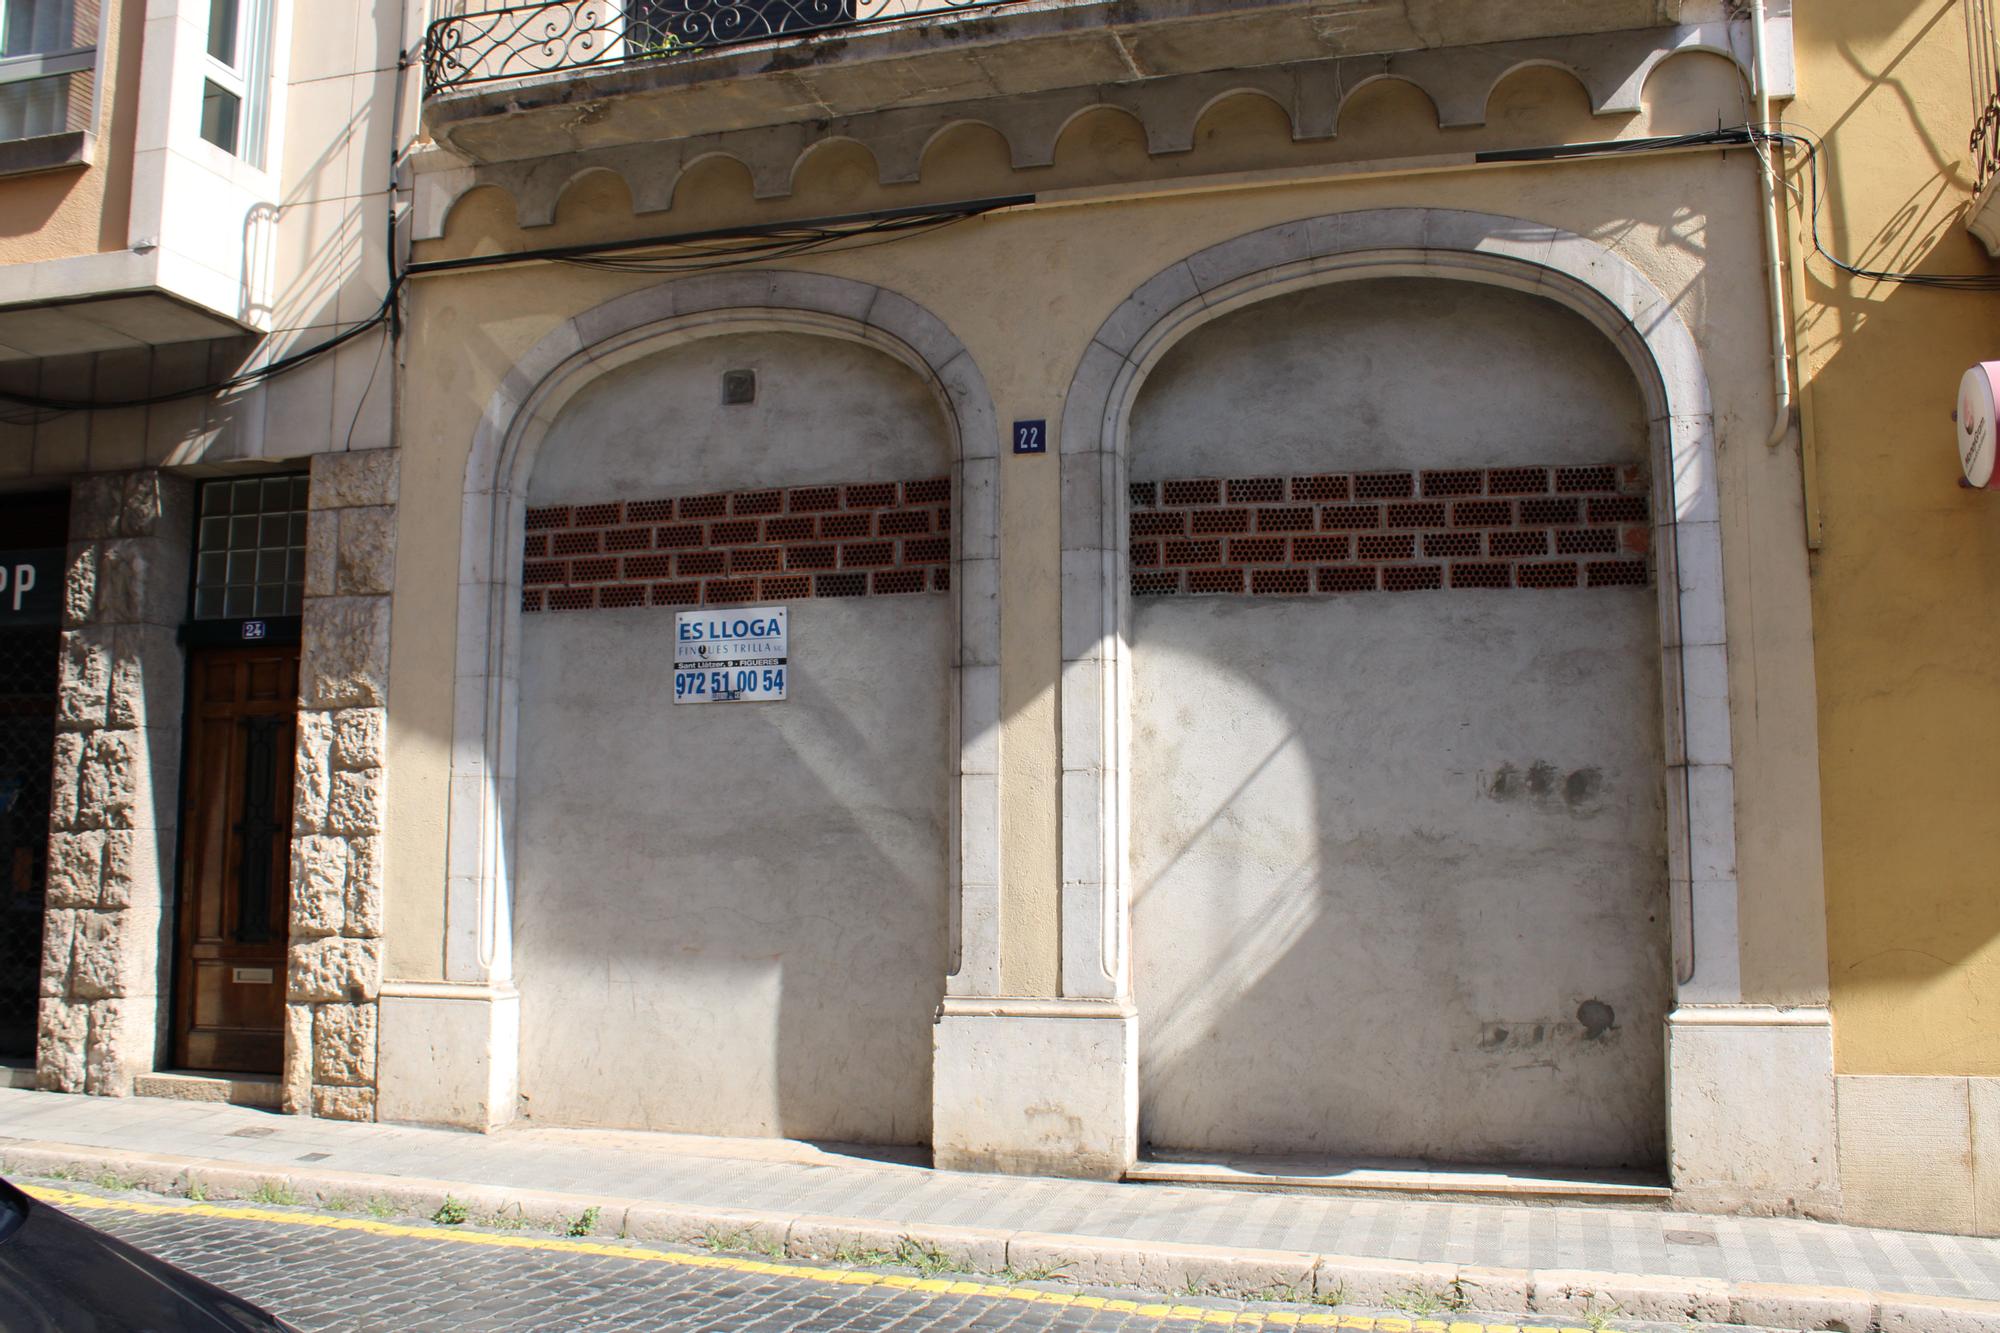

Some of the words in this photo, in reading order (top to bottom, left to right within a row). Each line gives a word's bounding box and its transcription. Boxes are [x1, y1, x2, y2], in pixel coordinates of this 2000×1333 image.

[1020, 427, 1038, 449] 22
[246, 623, 262, 637] 24
[680, 622, 703, 640] ES
[710, 618, 781, 639] LLOGA
[678, 644, 729, 659] FINQUES
[734, 643, 770, 653] TRILLA
[740, 658, 778, 667] FIGUERES
[676, 672, 706, 695] 972
[711, 671, 729, 694] 51
[737, 670, 758, 692] 00
[763, 669, 784, 692] 54
